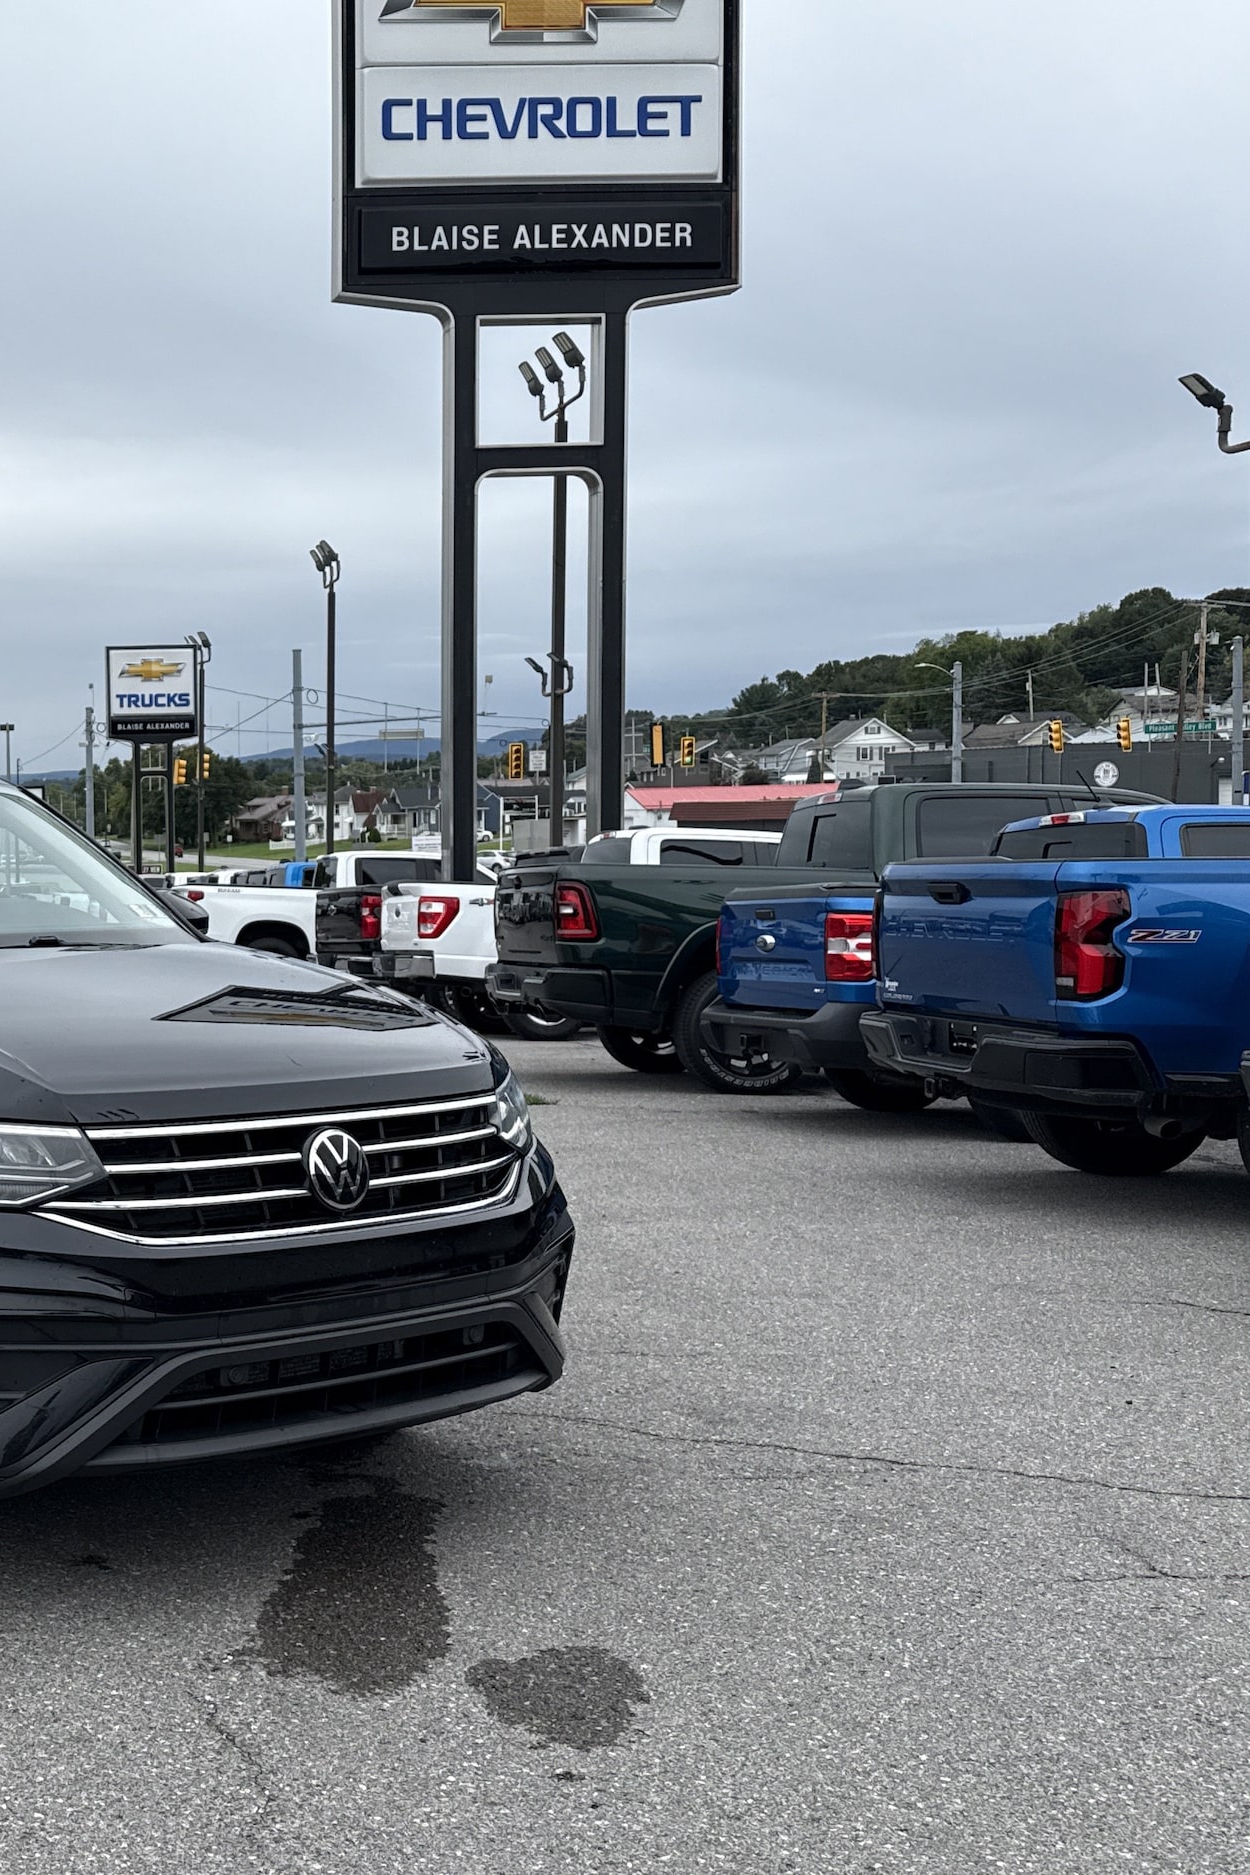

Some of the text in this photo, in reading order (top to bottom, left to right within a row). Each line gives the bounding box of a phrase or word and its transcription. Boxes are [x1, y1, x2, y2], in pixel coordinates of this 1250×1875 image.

[382, 95, 702, 140] CHEVROLET
[391, 222, 693, 252] BLAISE ALEXANDER
[115, 693, 190, 708] TRUCKS
[117, 722, 190, 731] BLAISE ALEXANDER
[1148, 724, 1175, 732] Pleasant
[1198, 722, 1212, 730] Blvd
[1127, 929, 1202, 943] Z71
